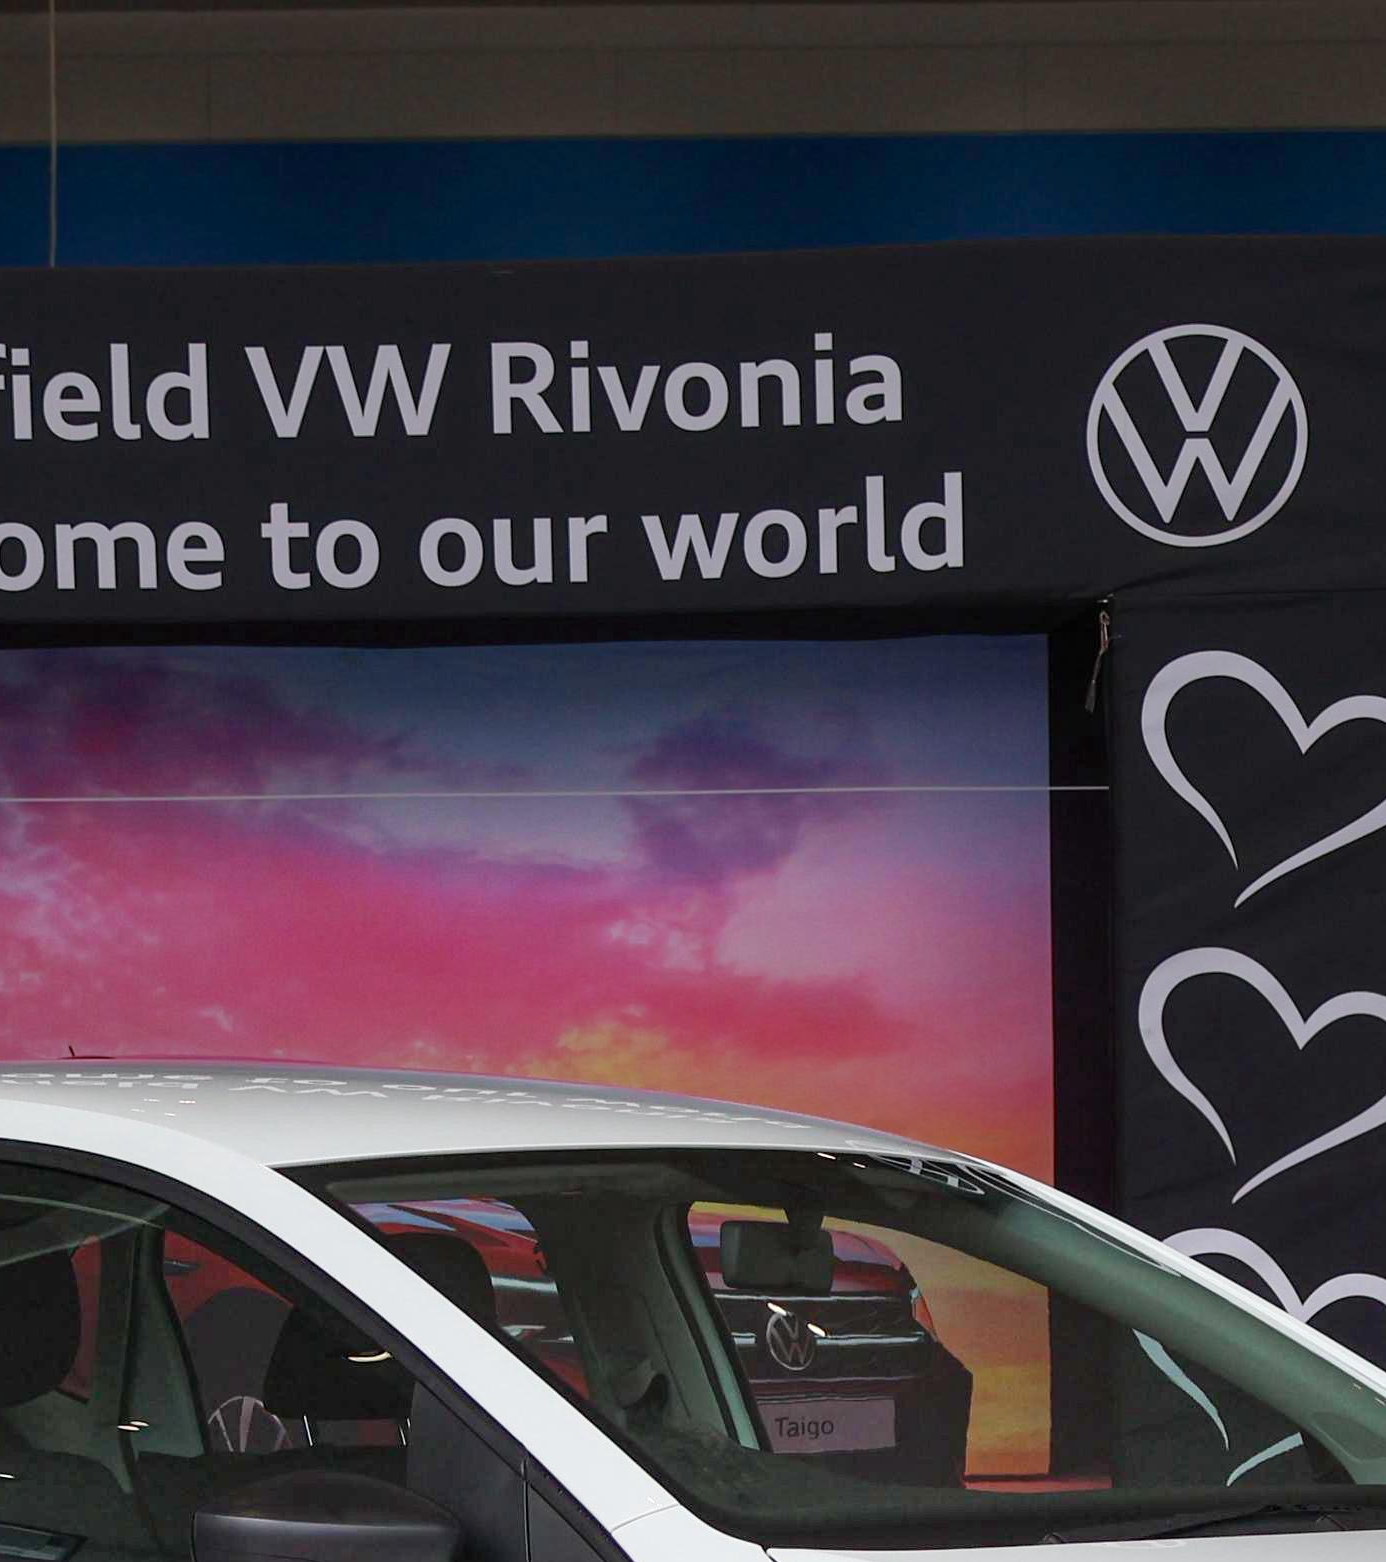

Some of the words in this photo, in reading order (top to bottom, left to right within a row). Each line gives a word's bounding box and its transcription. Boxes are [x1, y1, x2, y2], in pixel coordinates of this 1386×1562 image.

[245, 342, 452, 440] VW
[491, 332, 905, 436] Rivonia
[260, 501, 381, 590] to
[419, 513, 608, 588] our
[643, 472, 966, 582] world
[774, 1416, 835, 1439] Taigo
